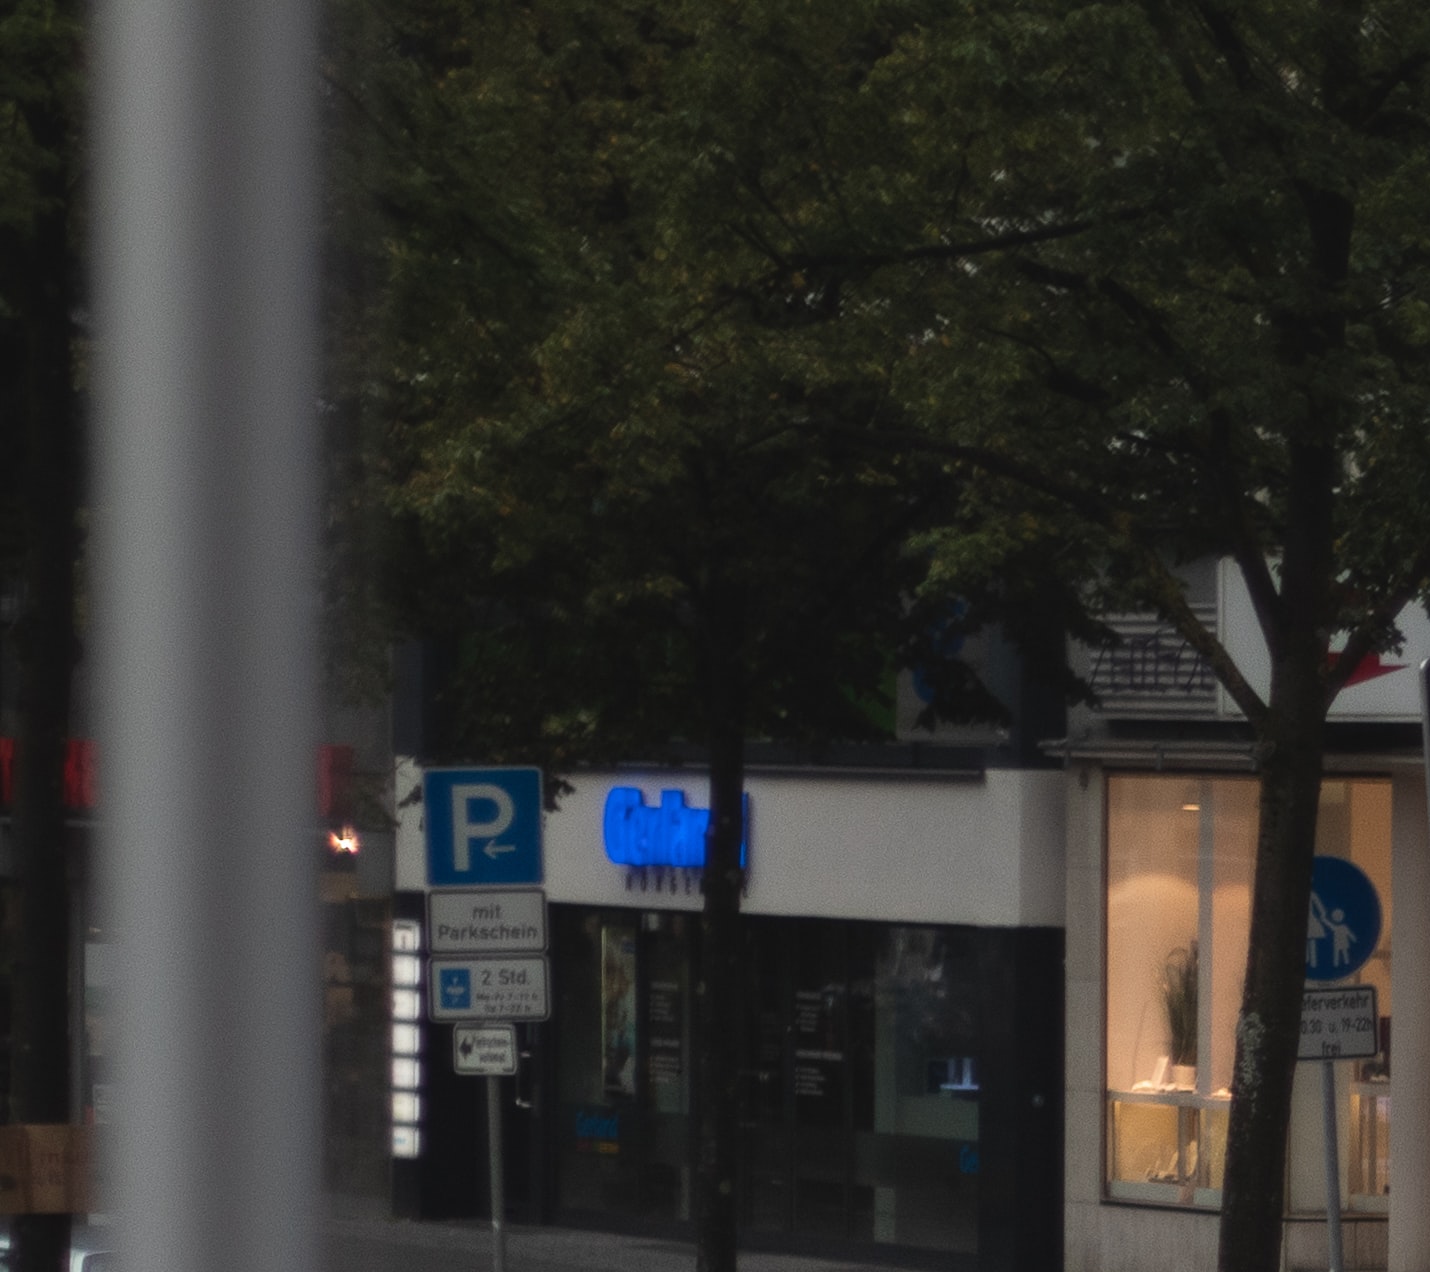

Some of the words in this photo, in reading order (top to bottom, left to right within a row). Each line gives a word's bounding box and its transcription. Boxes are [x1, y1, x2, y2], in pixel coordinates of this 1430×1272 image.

[452, 783, 514, 872] P
[473, 905, 501, 919] mit
[438, 925, 538, 941] Parkschein
[481, 970, 491, 986] 2
[1322, 1040, 1341, 1056] frei
